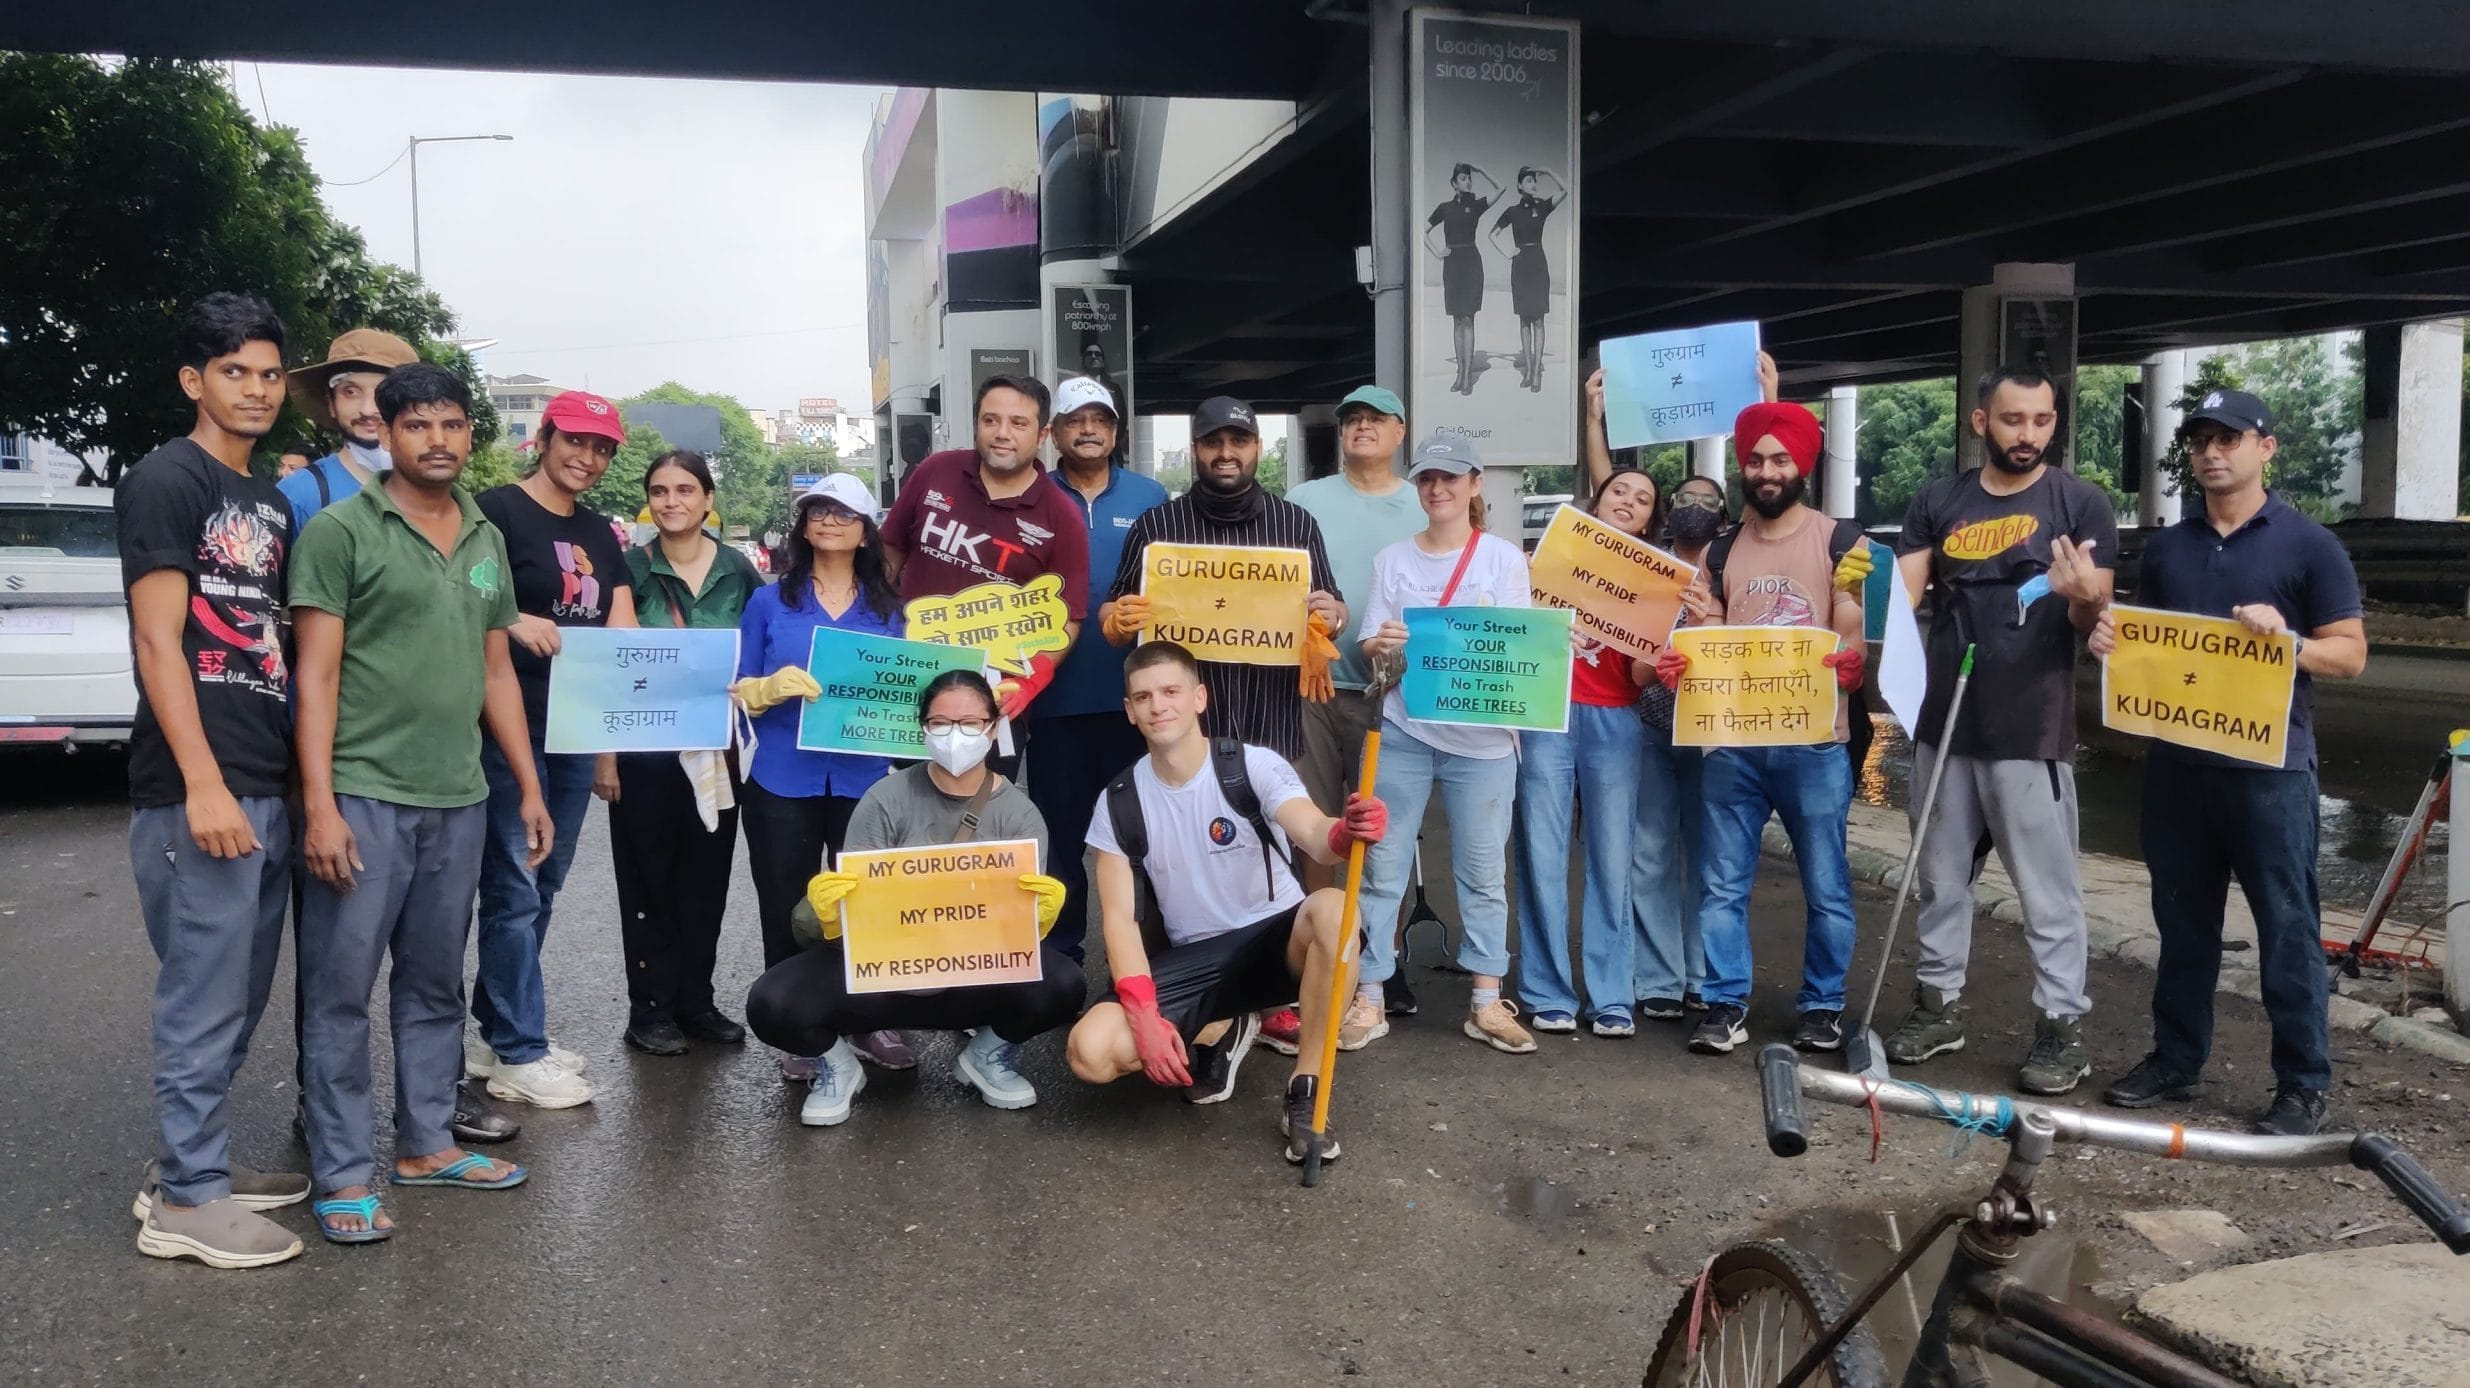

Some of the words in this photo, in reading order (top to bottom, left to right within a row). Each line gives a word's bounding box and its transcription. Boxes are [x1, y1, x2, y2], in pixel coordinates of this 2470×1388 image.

[1435, 34, 1504, 62] Leading
[1507, 40, 1557, 62] ladies
[1436, 60, 1477, 79] since
[1480, 62, 1527, 83] 2006
[1064, 312, 1106, 323] patriarchy
[1108, 312, 1117, 320] at
[1071, 321, 1112, 333] 800kmph
[1651, 343, 1707, 368] गुरुग्राम
[800, 399, 836, 407] HOTEL
[1650, 401, 1715, 427] कूड़ाग्राम
[1457, 426, 1492, 438] Power
[920, 511, 1025, 573] HKT
[1947, 519, 2036, 553] Seinfeld
[1571, 521, 1595, 538] MY
[1594, 532, 1676, 580] GURUGRAM
[920, 545, 969, 568] HACKETT
[970, 564, 1017, 585] SPORT
[1157, 558, 1300, 583] GURUGRAM
[200, 582, 236, 597] YOUNG
[1571, 566, 1595, 584] MY
[1596, 577, 1638, 605] PRIDE
[1747, 577, 1793, 595] DIOR
[918, 606, 948, 625] हम
[955, 593, 1005, 620] अपने
[1009, 587, 1050, 608] शहर
[956, 625, 1000, 646] साफ
[1154, 623, 1294, 649] KUDAGRAM
[1445, 617, 1479, 632] Your
[1483, 620, 1528, 635] Street
[1464, 638, 1506, 652] YOUR
[1700, 641, 1754, 664] सड़क
[1759, 641, 1786, 657] पर
[1792, 640, 1813, 656] ना
[2121, 622, 2284, 666] GURUGRAM
[616, 647, 680, 668] गुरुग्राम
[856, 648, 891, 665] Your
[895, 654, 940, 670] Street
[1422, 655, 1541, 675] RESPONSIBILITY
[873, 671, 917, 686] YOUR
[1451, 677, 1471, 690] No
[1475, 678, 1514, 693] Trash
[1683, 678, 1733, 695] कचरा
[828, 684, 921, 704] RESPONSIBI
[1436, 696, 1479, 711] MORE
[1483, 699, 1526, 714] TREES
[603, 710, 678, 734] कूड़ाग्राम
[857, 706, 878, 720] No
[882, 709, 920, 723] Trash
[1695, 714, 1716, 732] ना
[1723, 707, 1773, 732] फैलने
[1780, 706, 1811, 731] देंगे
[2117, 694, 2271, 745] KUDAGRAM
[841, 724, 885, 740] MORE
[890, 728, 925, 743] TREE
[868, 861, 896, 878] MY
[902, 852, 1015, 875] GURUGRAM
[900, 909, 928, 925] MY
[934, 904, 987, 922] PRIDE
[856, 962, 883, 979] MY
[890, 951, 1034, 976] RESPONSIBILITY
